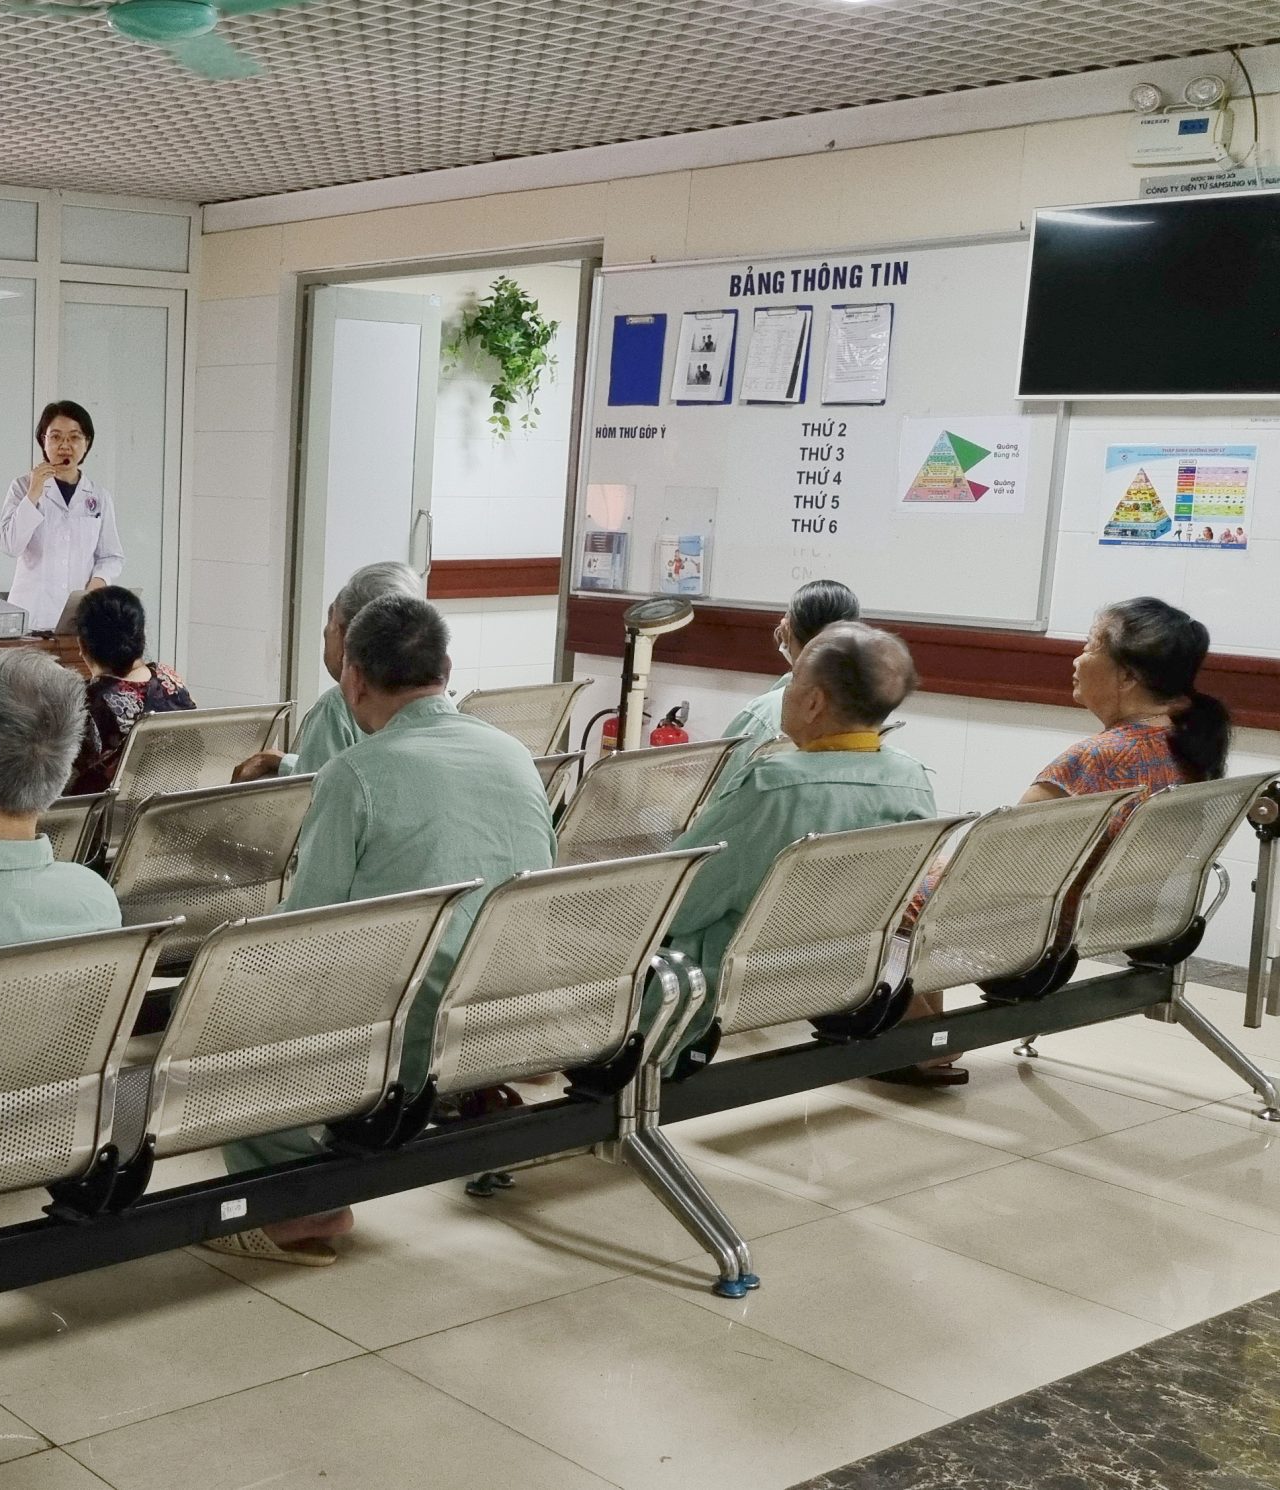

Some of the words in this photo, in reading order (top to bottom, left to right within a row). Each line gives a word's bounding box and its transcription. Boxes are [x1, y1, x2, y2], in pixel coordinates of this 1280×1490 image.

[1145, 185, 1169, 195] CÔNG
[1170, 185, 1180, 193] TY
[1208, 179, 1245, 190] SAMSUNG
[729, 265, 785, 297] BẢNG
[790, 262, 863, 293] THÔNG
[870, 261, 909, 287] TIN
[595, 424, 617, 439] HÒM
[619, 425, 639, 439] THƯ
[639, 424, 658, 439] GÓP
[660, 424, 667, 439] Ý
[801, 418, 835, 437] THỨ
[837, 422, 847, 437] 2
[799, 443, 833, 461] THỨ
[835, 447, 845, 461] 3
[796, 466, 830, 485] THỨ
[832, 471, 842, 485] 4
[793, 490, 827, 509] THỨ
[830, 495, 840, 509] 5
[791, 514, 826, 533] THỨ
[828, 519, 838, 534] 6
